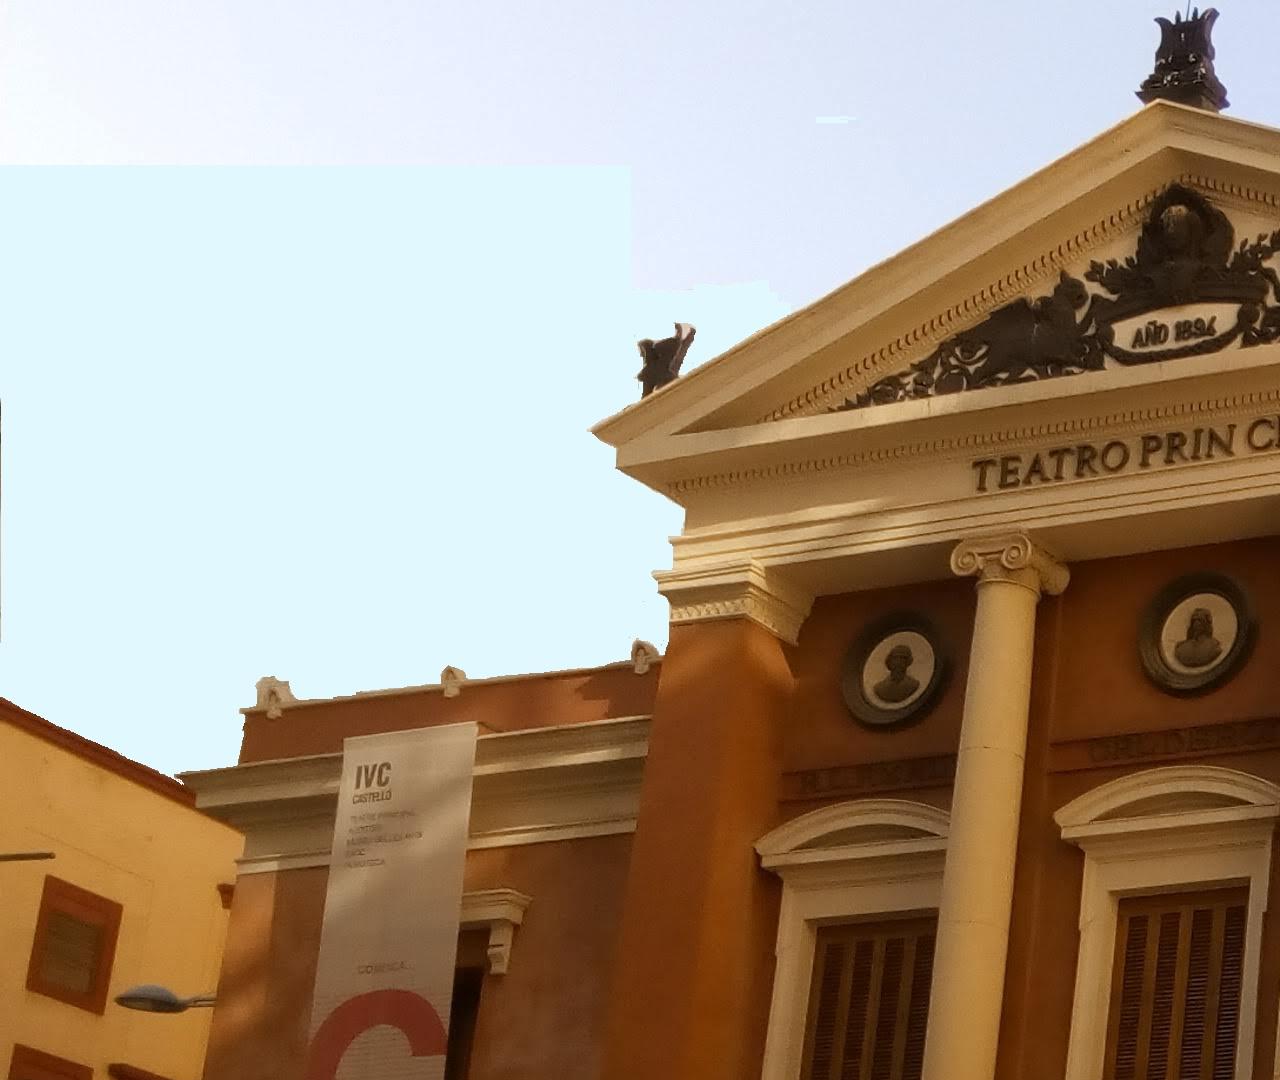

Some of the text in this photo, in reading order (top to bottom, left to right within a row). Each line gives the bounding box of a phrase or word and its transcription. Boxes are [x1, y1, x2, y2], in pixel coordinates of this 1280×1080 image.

[1132, 314, 1219, 350] AÑO 1894
[972, 440, 1131, 492] TEATRO
[354, 761, 392, 790] IVC
[352, 789, 393, 804] CASTELLÓ
